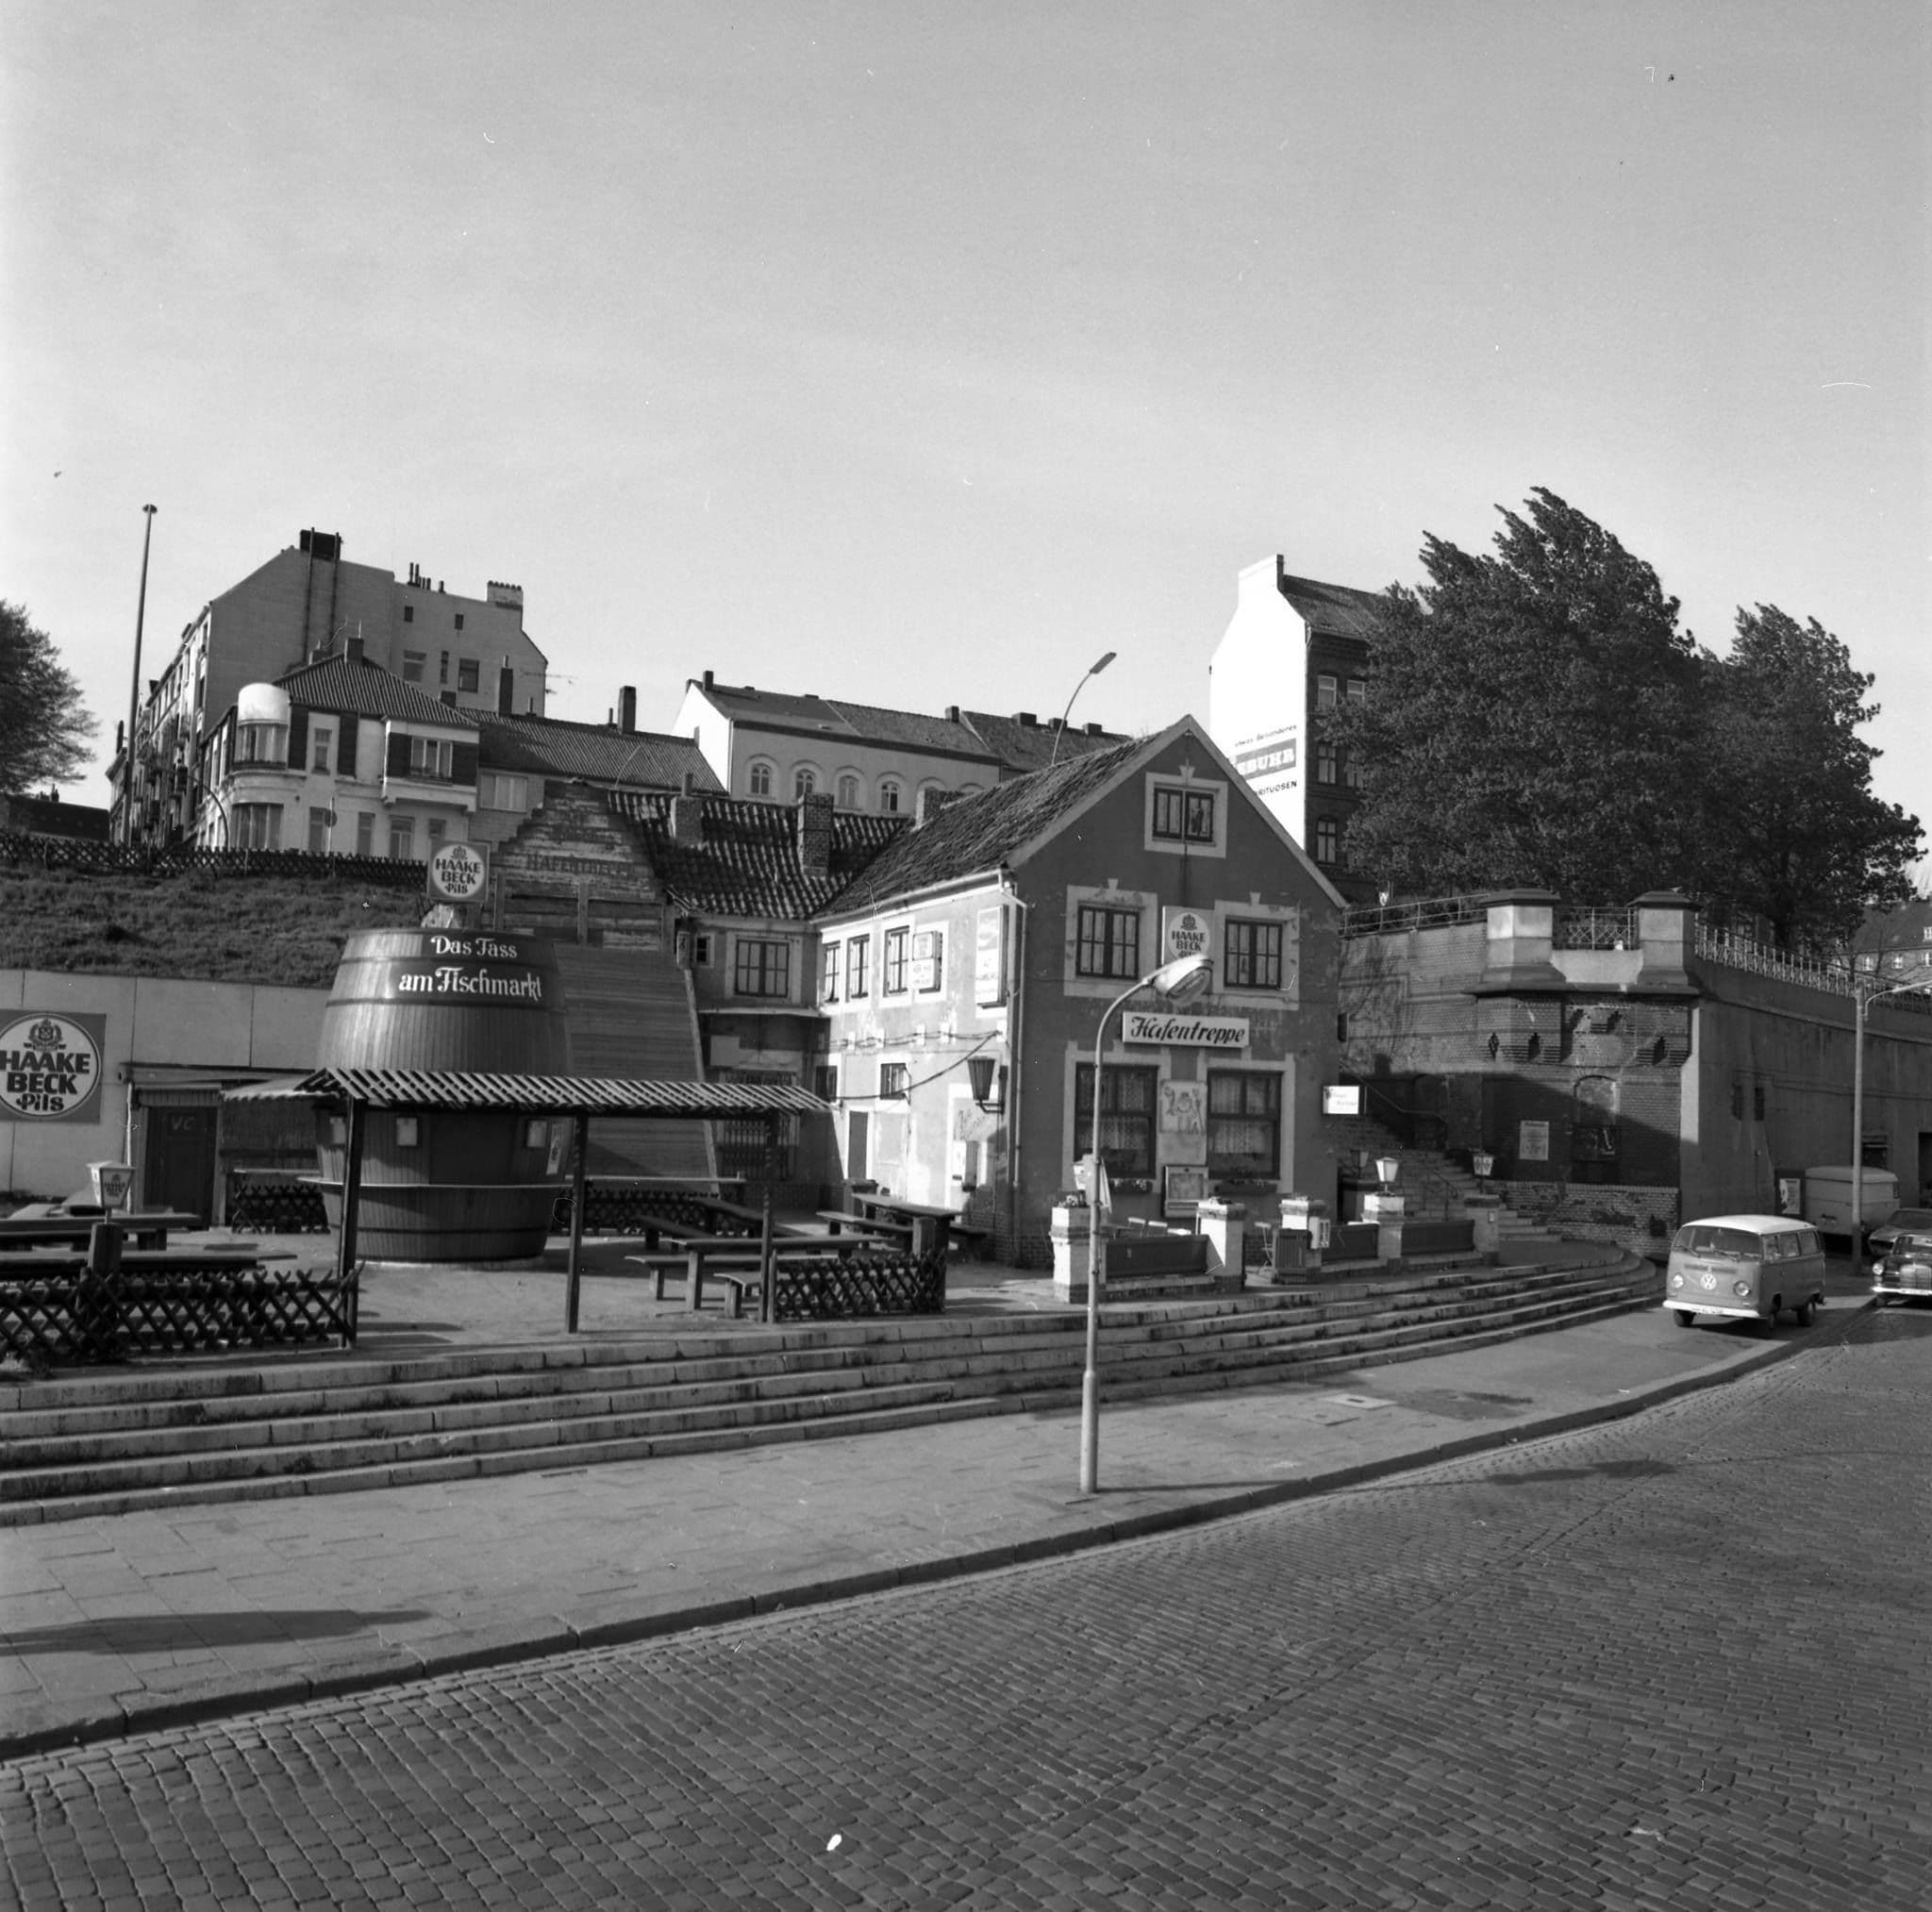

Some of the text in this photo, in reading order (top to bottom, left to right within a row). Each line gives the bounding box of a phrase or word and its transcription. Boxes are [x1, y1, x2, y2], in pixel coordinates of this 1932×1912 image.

[436, 858, 481, 873] HAAKE
[441, 872, 475, 885] BECK
[430, 935, 472, 956] Das
[1172, 930, 1205, 942] HAAKE
[1176, 940, 1202, 952] BECK
[398, 966, 542, 1002] am Fischmarkt
[1131, 1016, 1245, 1044] Hafentreppe
[0, 1050, 91, 1073] HAAKE
[7, 1072, 77, 1094] BECK
[16, 1093, 64, 1111] Pils
